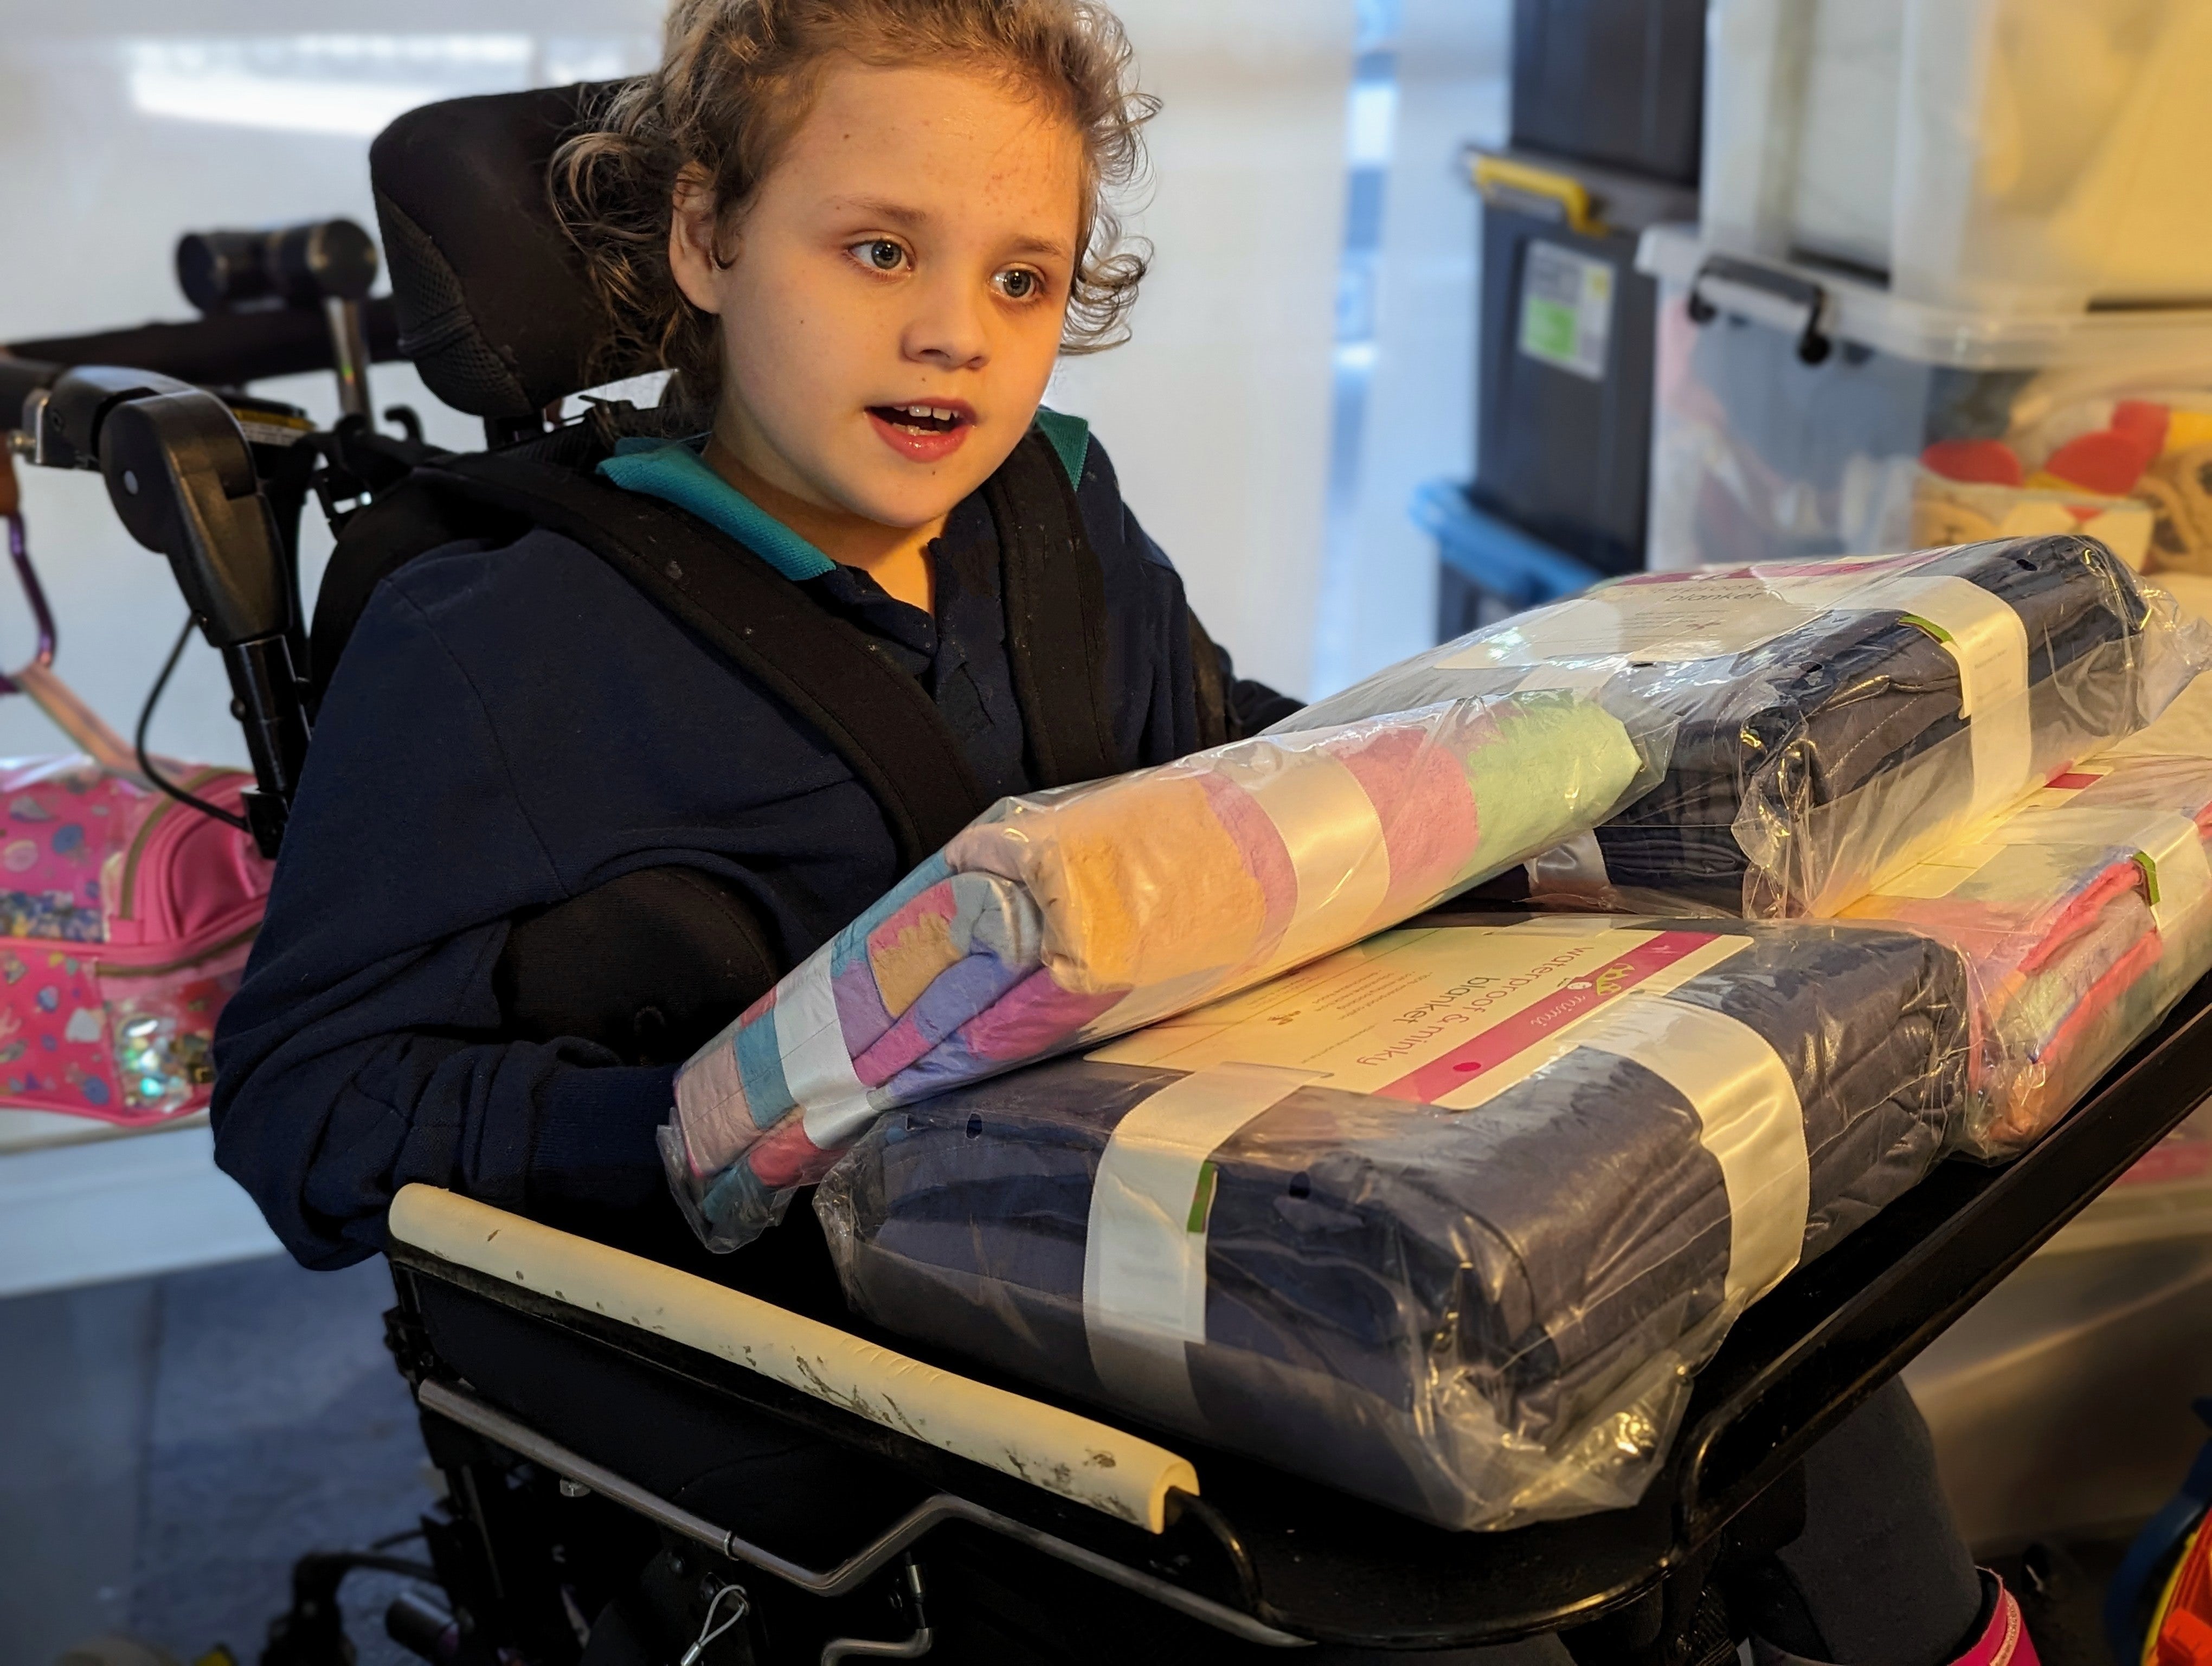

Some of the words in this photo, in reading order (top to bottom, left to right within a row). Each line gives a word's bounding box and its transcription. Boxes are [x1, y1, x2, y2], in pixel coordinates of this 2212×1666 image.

[1462, 947, 1594, 1012] waterproof
[1393, 977, 1500, 1023] blanket
[1437, 1014, 1469, 1023] &
[1531, 995, 1585, 1026] mimi
[1357, 1026, 1443, 1065] minky
